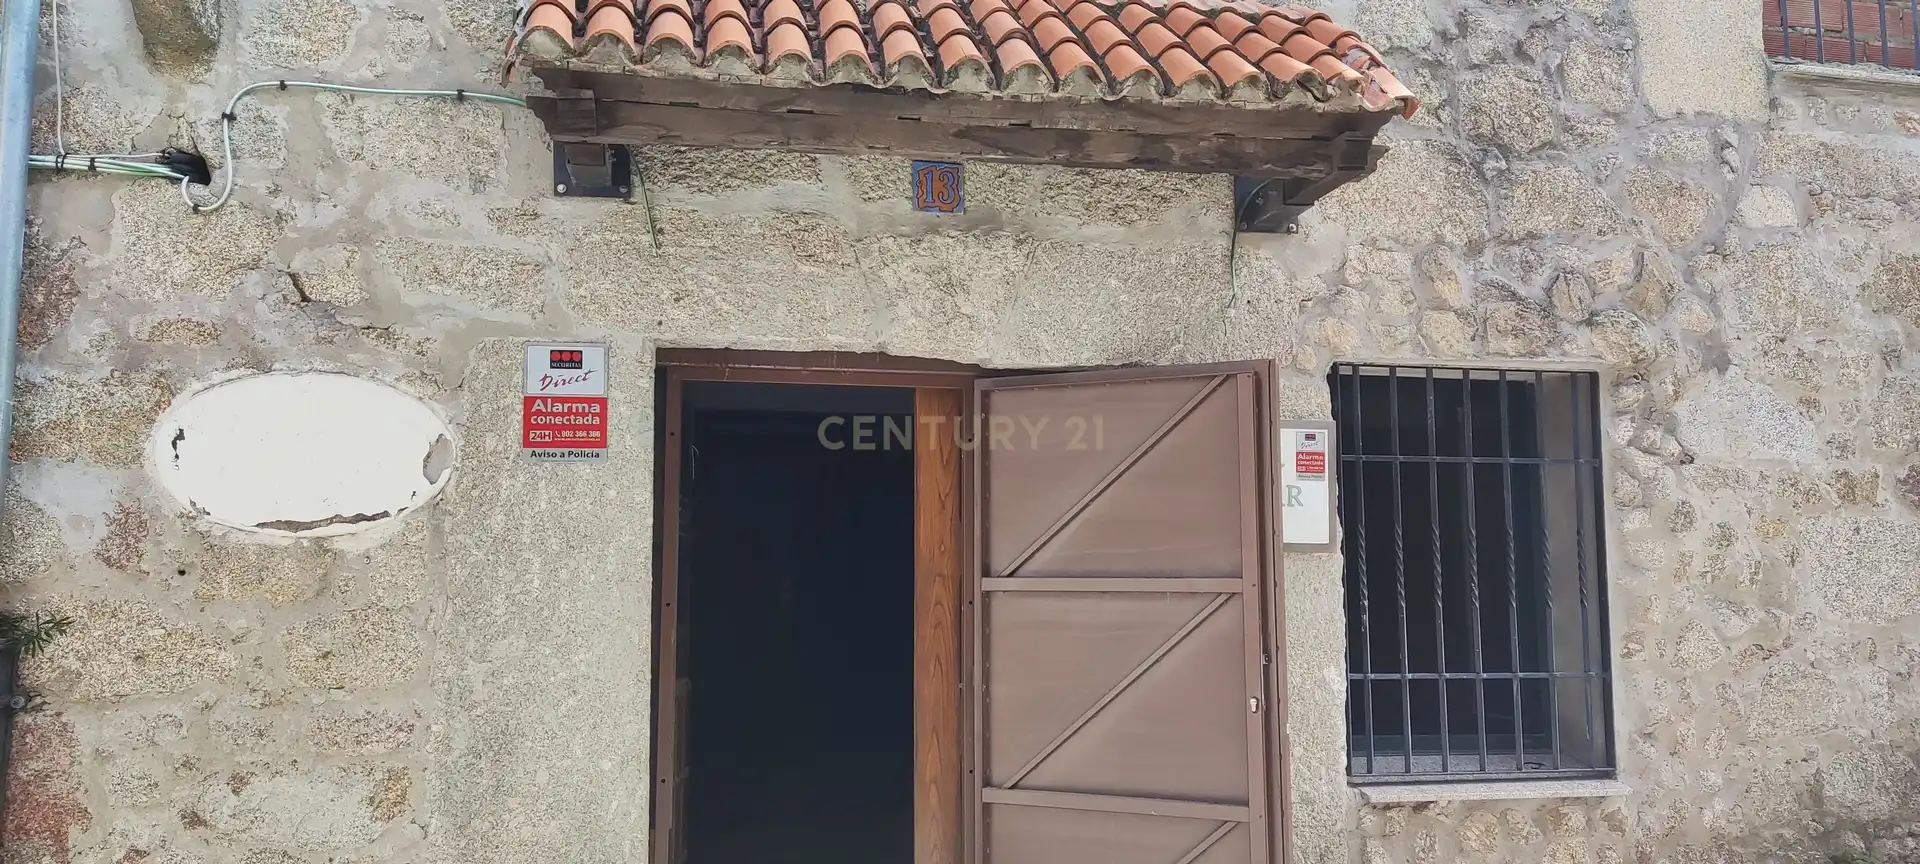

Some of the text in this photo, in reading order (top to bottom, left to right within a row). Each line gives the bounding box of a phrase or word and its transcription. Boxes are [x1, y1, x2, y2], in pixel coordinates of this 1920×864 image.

[924, 170, 955, 204] 13
[539, 368, 597, 391] Direct
[531, 398, 600, 413] Alarma
[531, 413, 600, 425] conectada
[531, 431, 551, 441] 24H
[530, 450, 557, 458] Aviso
[568, 450, 600, 458] Policía
